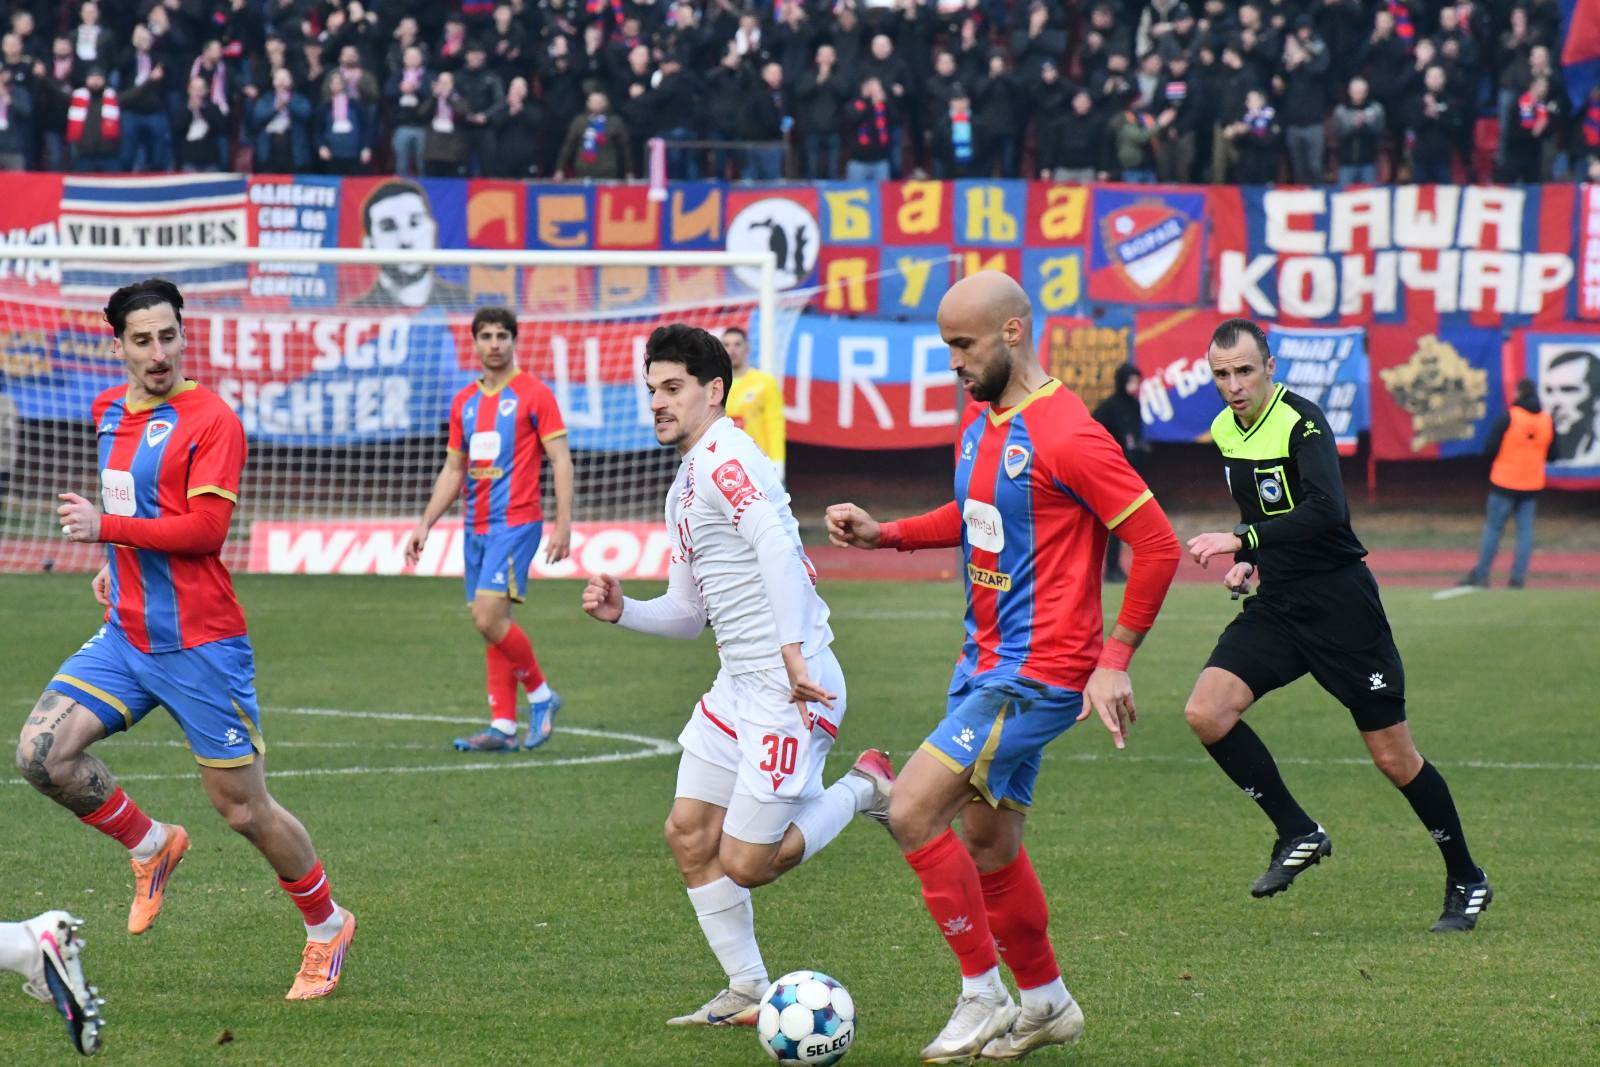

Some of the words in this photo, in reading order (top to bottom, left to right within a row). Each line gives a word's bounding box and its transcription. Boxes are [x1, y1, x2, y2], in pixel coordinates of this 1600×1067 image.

[67, 219, 239, 247] VULTURES
[1264, 184, 1525, 253] САША
[1218, 250, 1574, 318] КОНЧАР
[759, 734, 799, 775] 30
[806, 1030, 852, 1058] SELECT
